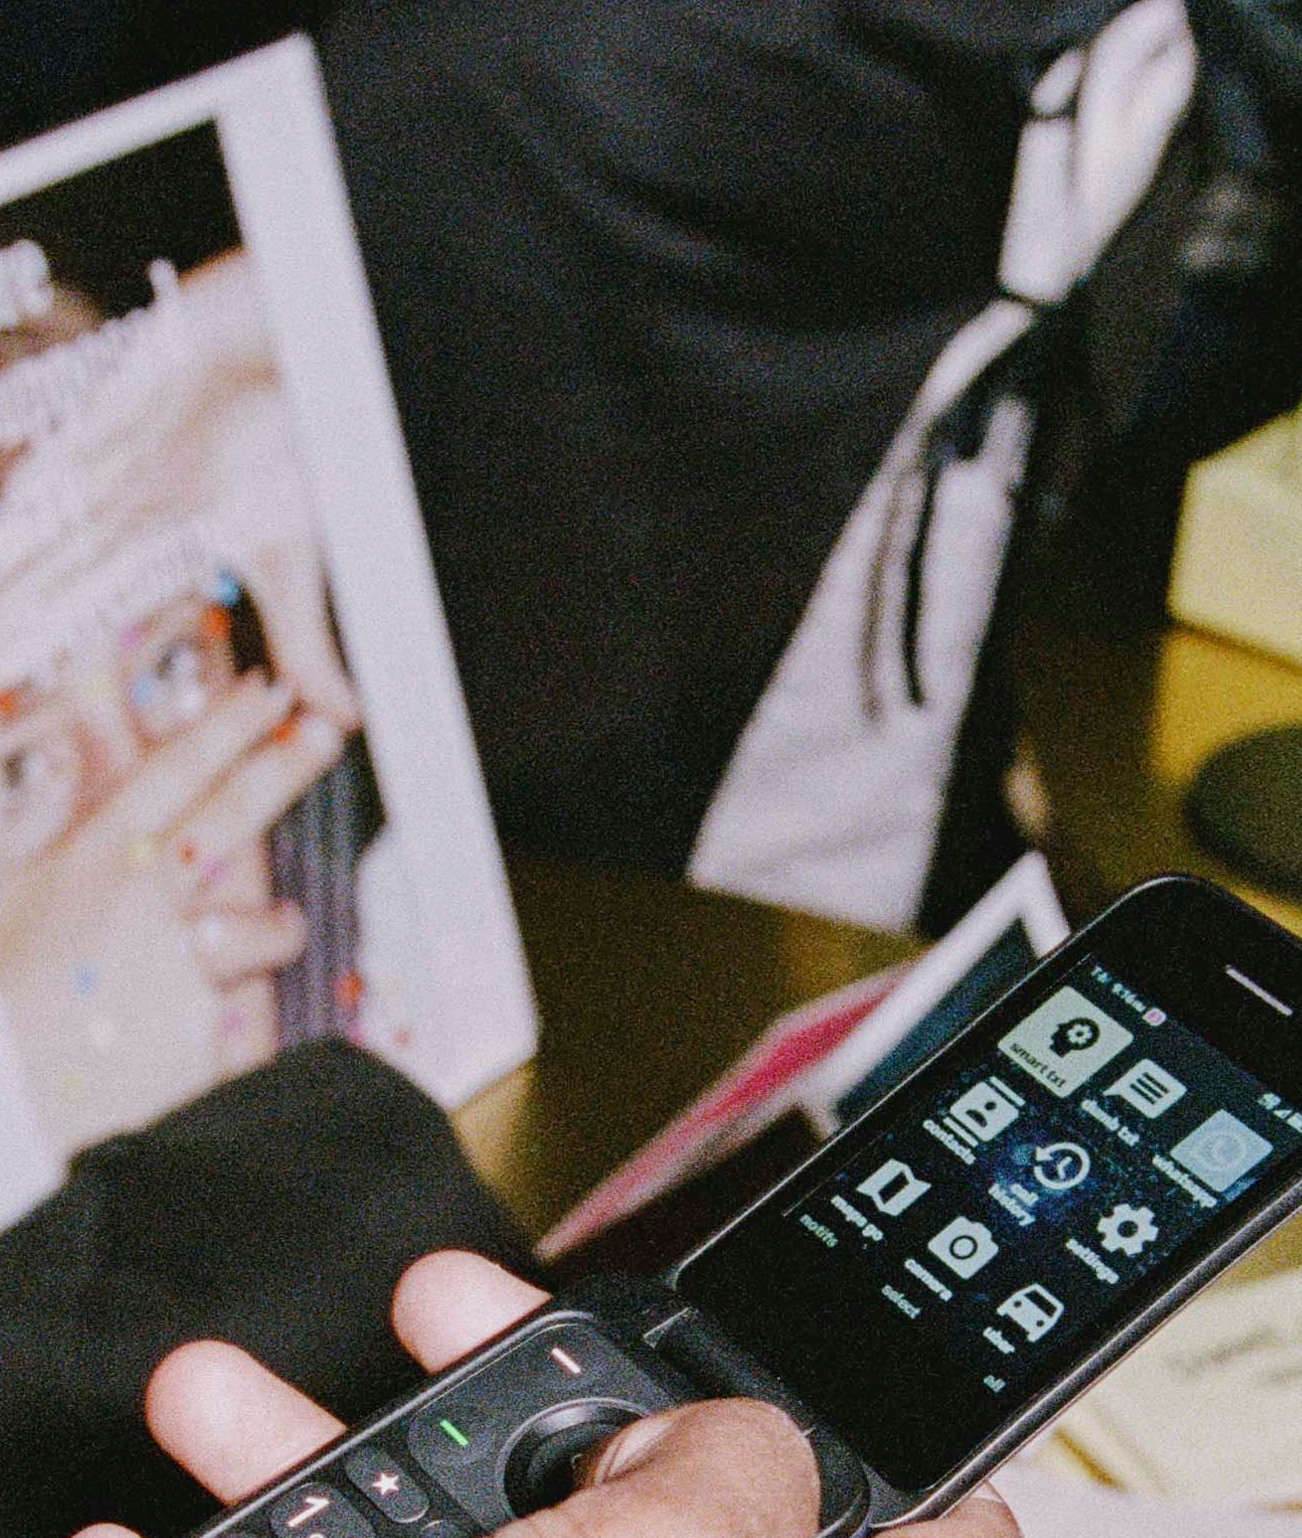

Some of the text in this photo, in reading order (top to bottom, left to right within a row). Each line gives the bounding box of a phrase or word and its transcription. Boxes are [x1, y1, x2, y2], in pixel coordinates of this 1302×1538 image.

[1010, 1043, 1068, 1088] smart txt
[923, 1119, 976, 1165] contacts
[1080, 1099, 1141, 1147] dumb txt
[1010, 1183, 1040, 1206] call
[1152, 1154, 1218, 1209] whatsapp
[831, 1194, 885, 1242] maps go
[988, 1183, 1037, 1227] history
[799, 1214, 839, 1248] notifs
[904, 1258, 953, 1302] camera
[1066, 1238, 1120, 1285] settings
[882, 1284, 921, 1319] select
[983, 1326, 1016, 1354] uber
[984, 1374, 1007, 1393] all
[287, 1496, 331, 1528] 1
